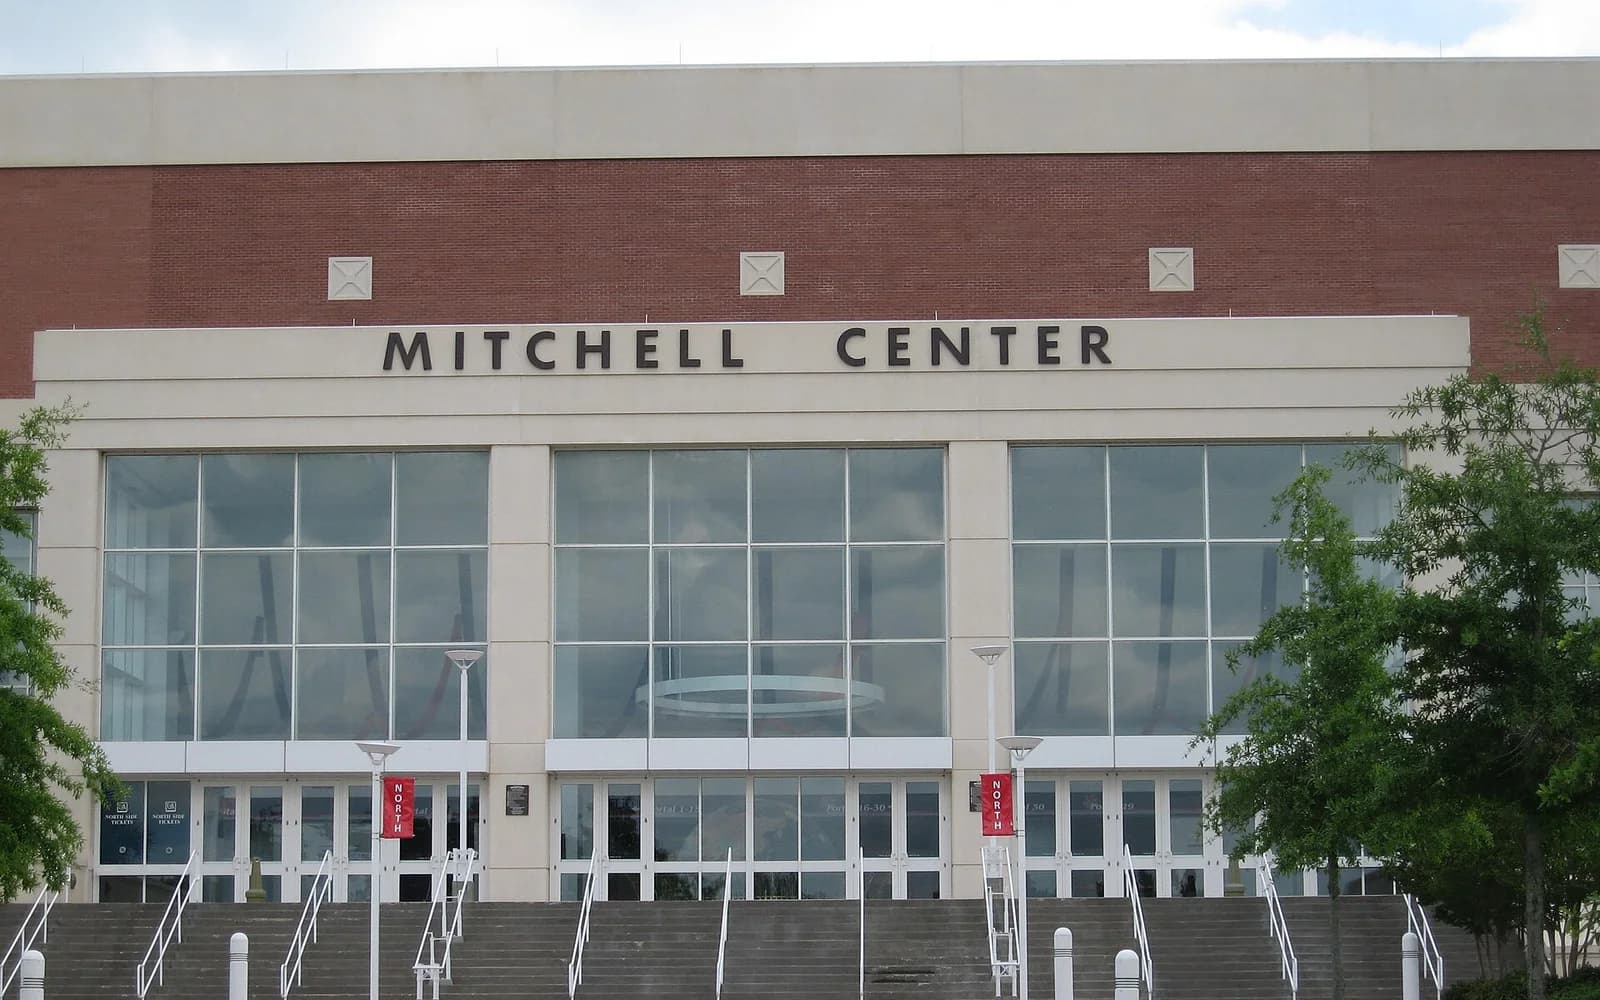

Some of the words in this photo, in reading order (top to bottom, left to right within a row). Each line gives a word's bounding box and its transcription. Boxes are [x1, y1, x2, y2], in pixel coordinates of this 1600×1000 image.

[383, 329, 744, 370] MITCHELL
[838, 326, 1112, 368] CENTER
[394, 784, 403, 832] NORTH
[992, 781, 1002, 830] NORTH
